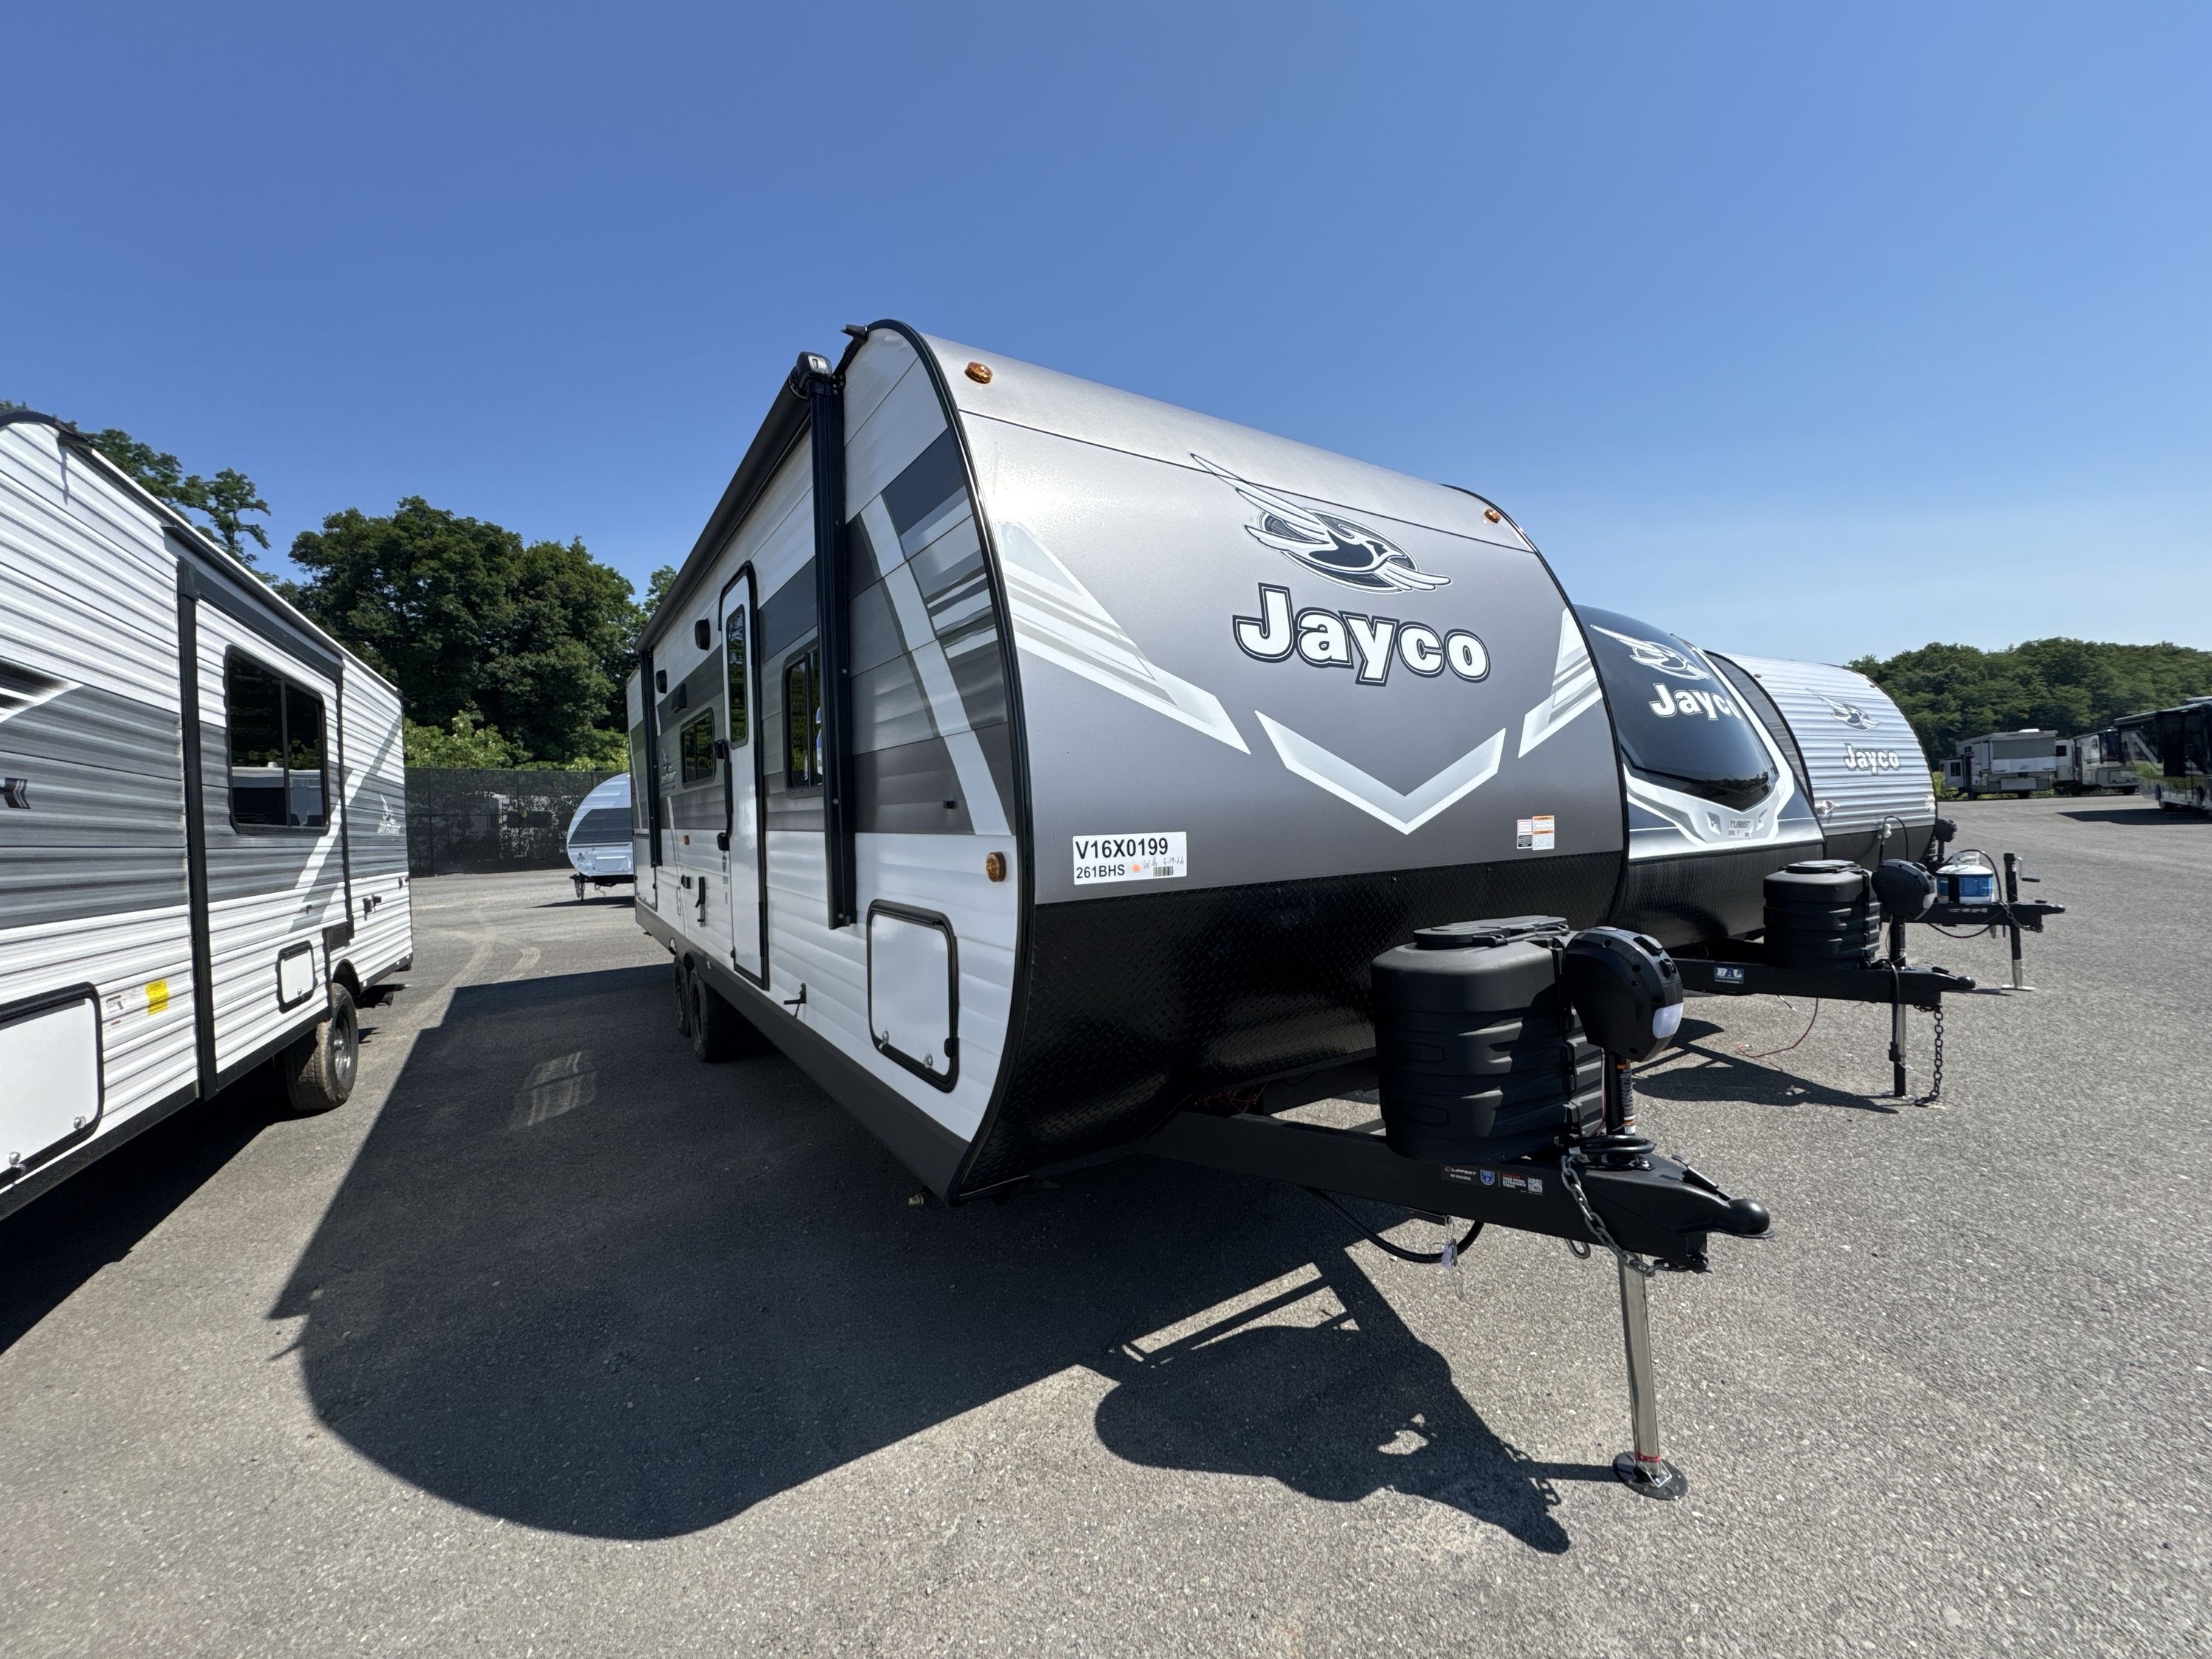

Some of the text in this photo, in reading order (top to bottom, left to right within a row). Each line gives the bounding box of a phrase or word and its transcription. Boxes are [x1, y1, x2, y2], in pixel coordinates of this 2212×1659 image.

[1233, 582, 1490, 686] Jayco
[1843, 743, 1900, 776] Jayco
[1075, 838, 1169, 859] V16X0199
[1077, 864, 1125, 878] 261BHS
